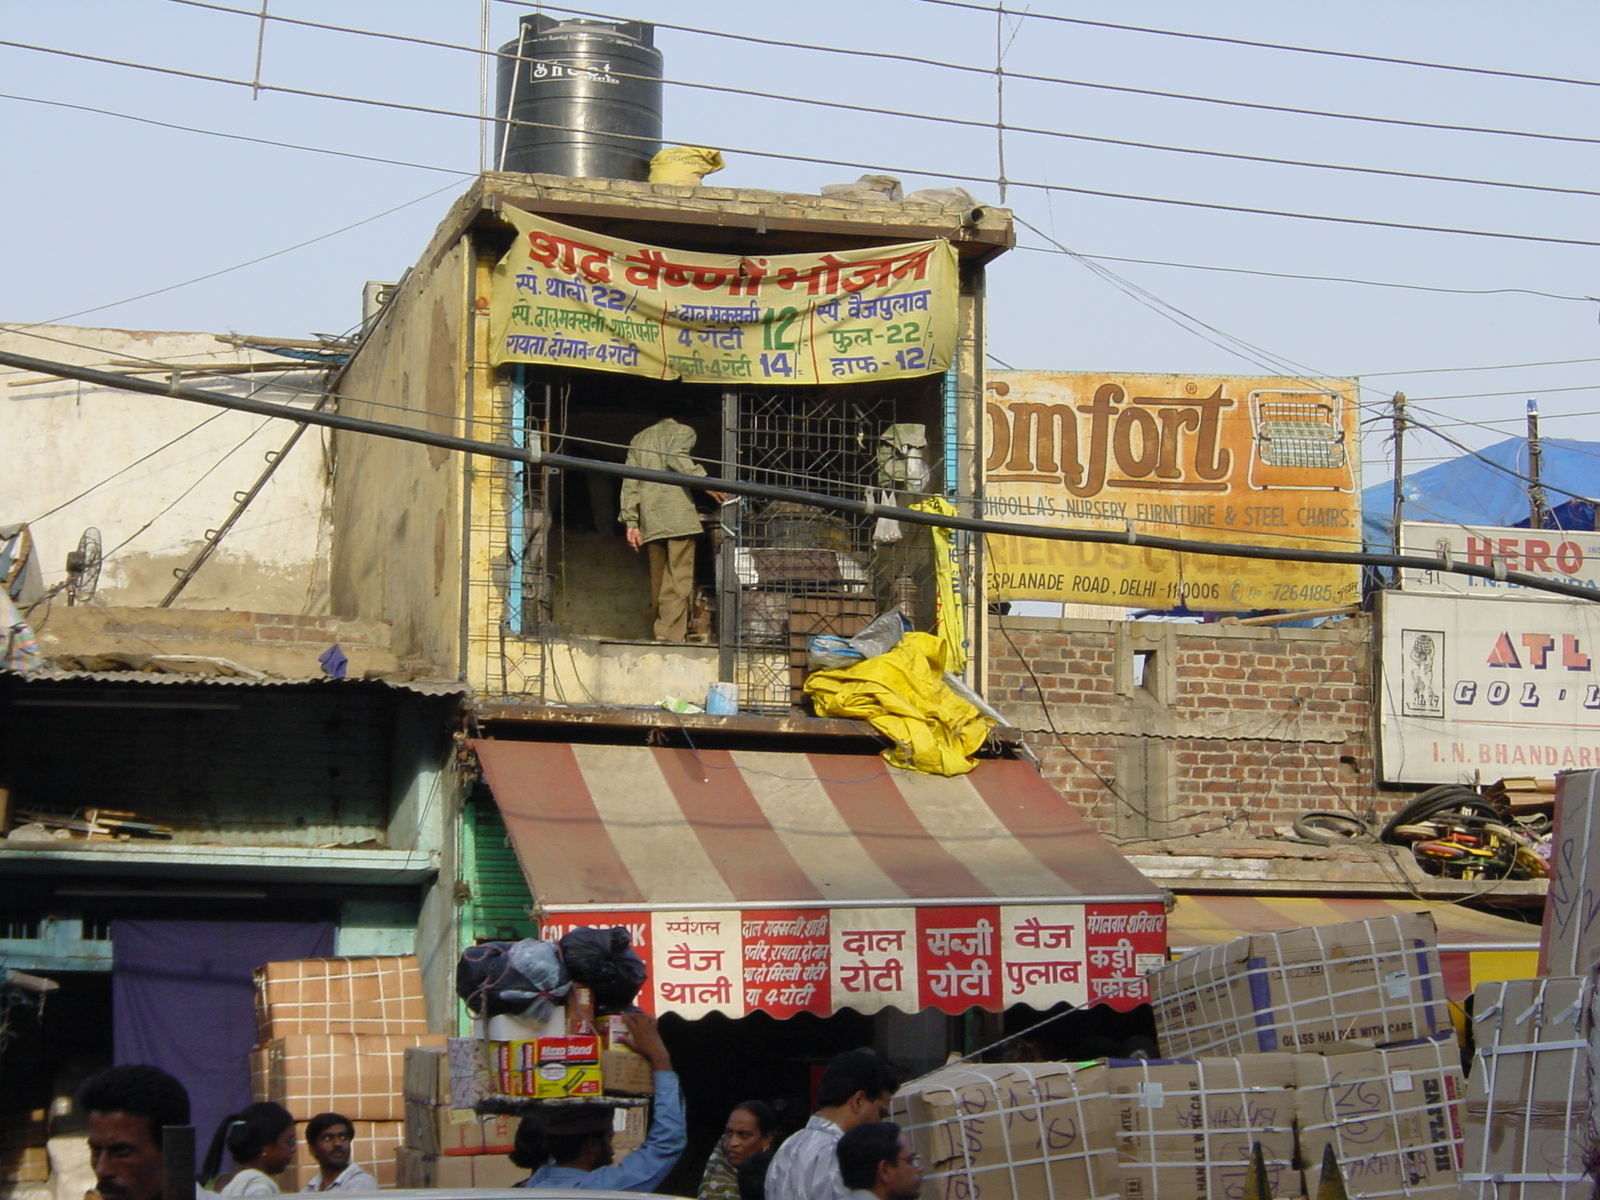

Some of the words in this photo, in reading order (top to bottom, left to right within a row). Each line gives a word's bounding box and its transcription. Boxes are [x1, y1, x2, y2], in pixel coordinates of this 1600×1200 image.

[777, 246, 936, 296] भोजन
[546, 277, 588, 304] थाली
[677, 328, 692, 348] 4
[986, 382, 1234, 497] omfort
[1136, 503, 1216, 527] FURNITURE
[1224, 505, 1237, 525] &
[1244, 506, 1289, 527] STEEL
[1466, 537, 1584, 574] HERO
[987, 572, 1064, 591] ESPLANADE
[1486, 631, 1592, 671] ATL
[841, 930, 906, 956] दाल
[925, 918, 994, 956] सब्जी
[1014, 917, 1074, 949] वैज
[667, 942, 725, 971] वैज
[660, 976, 733, 1004] थाली
[840, 958, 904, 992] रोटी
[926, 959, 992, 998] रोटी
[779, 983, 817, 1006] रोटी
